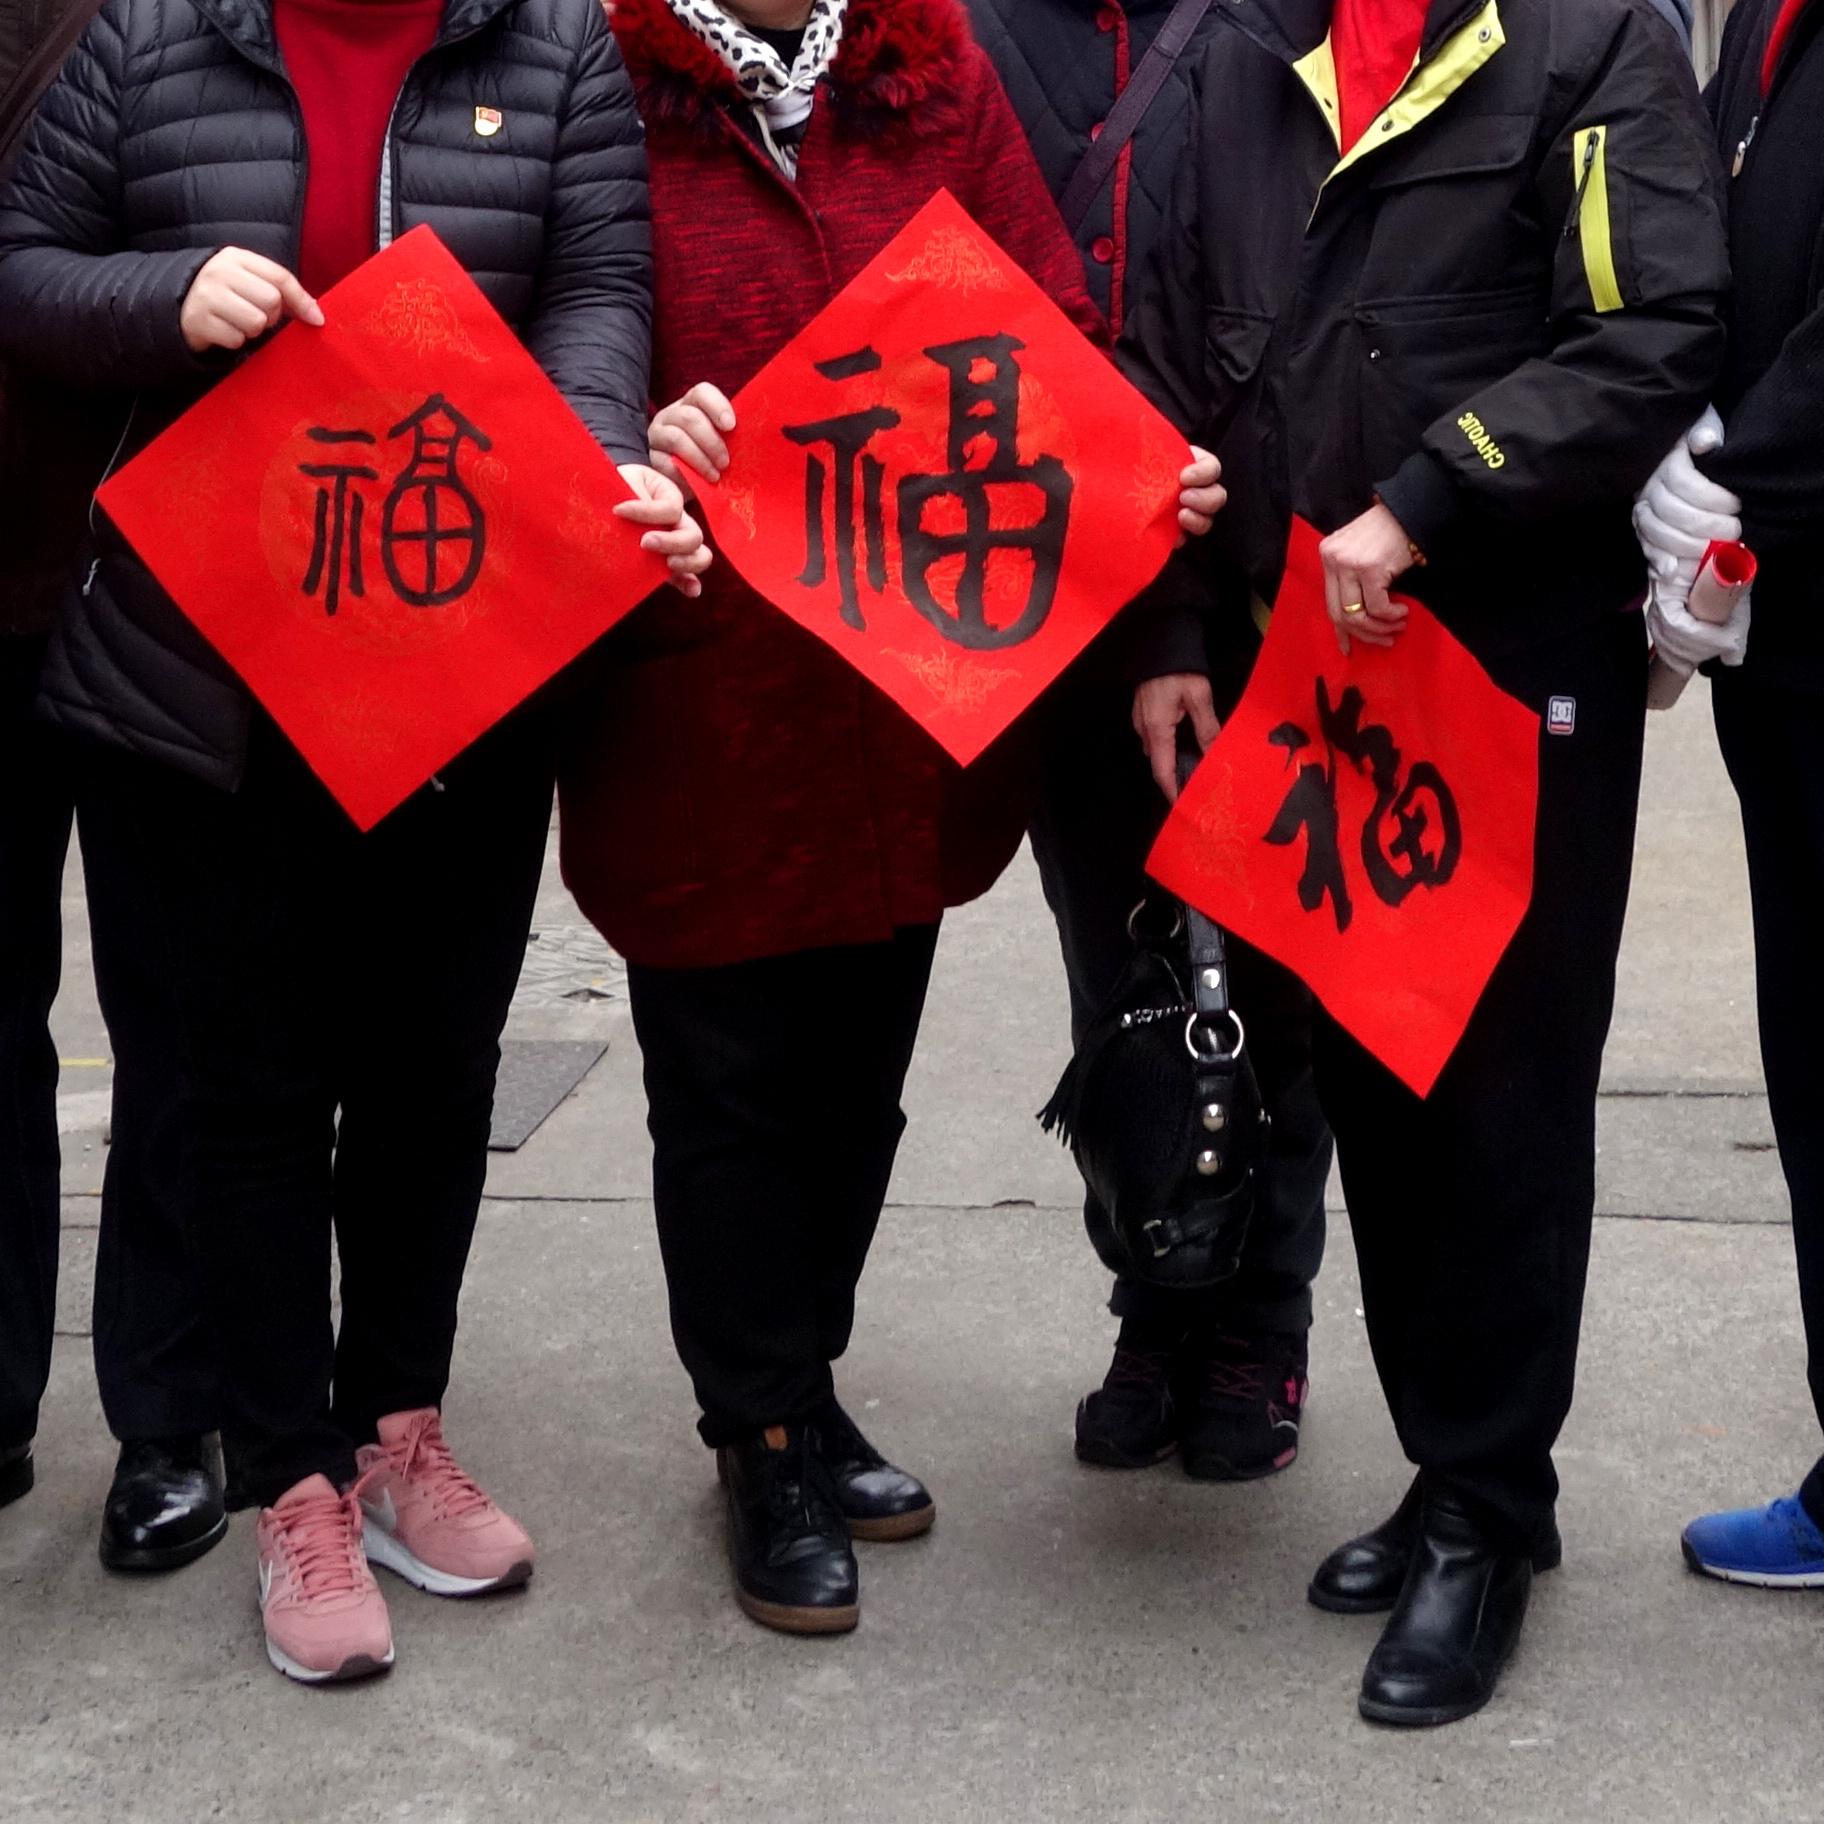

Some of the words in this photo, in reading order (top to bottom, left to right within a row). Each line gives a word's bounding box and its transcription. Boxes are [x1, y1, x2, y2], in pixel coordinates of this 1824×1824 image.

[297, 392, 492, 615] 福
[782, 332, 1074, 651] 福
[1264, 676, 1461, 932] 福
